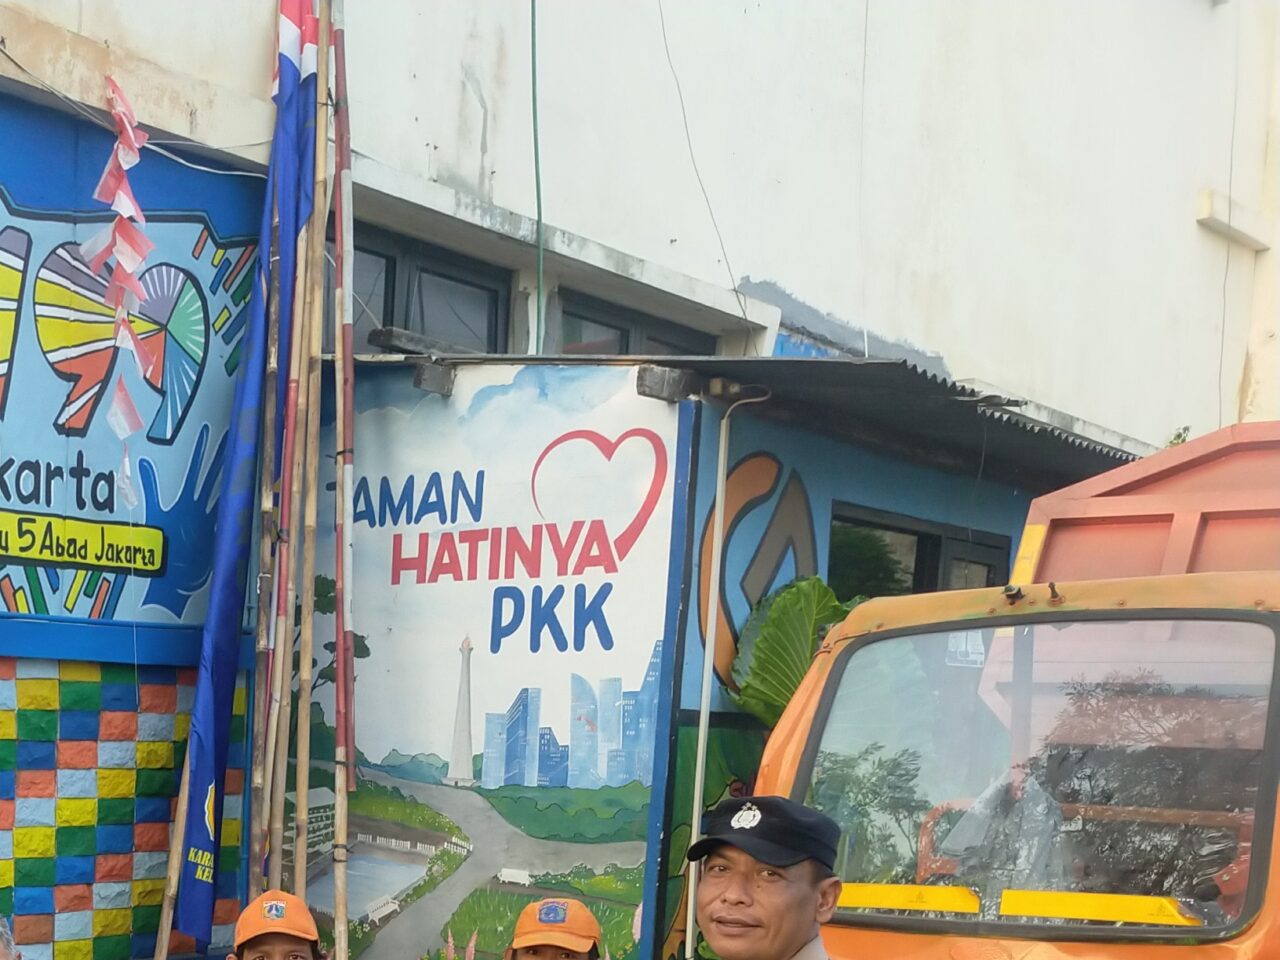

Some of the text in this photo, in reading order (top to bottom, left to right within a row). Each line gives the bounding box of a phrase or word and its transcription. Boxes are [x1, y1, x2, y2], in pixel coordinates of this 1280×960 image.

[326, 470, 485, 532] AMAN
[17, 517, 36, 553] 5
[39, 521, 88, 561] Abad
[95, 526, 156, 566] Jakarta
[391, 519, 619, 585] HATINYA
[490, 582, 614, 654] PKK
